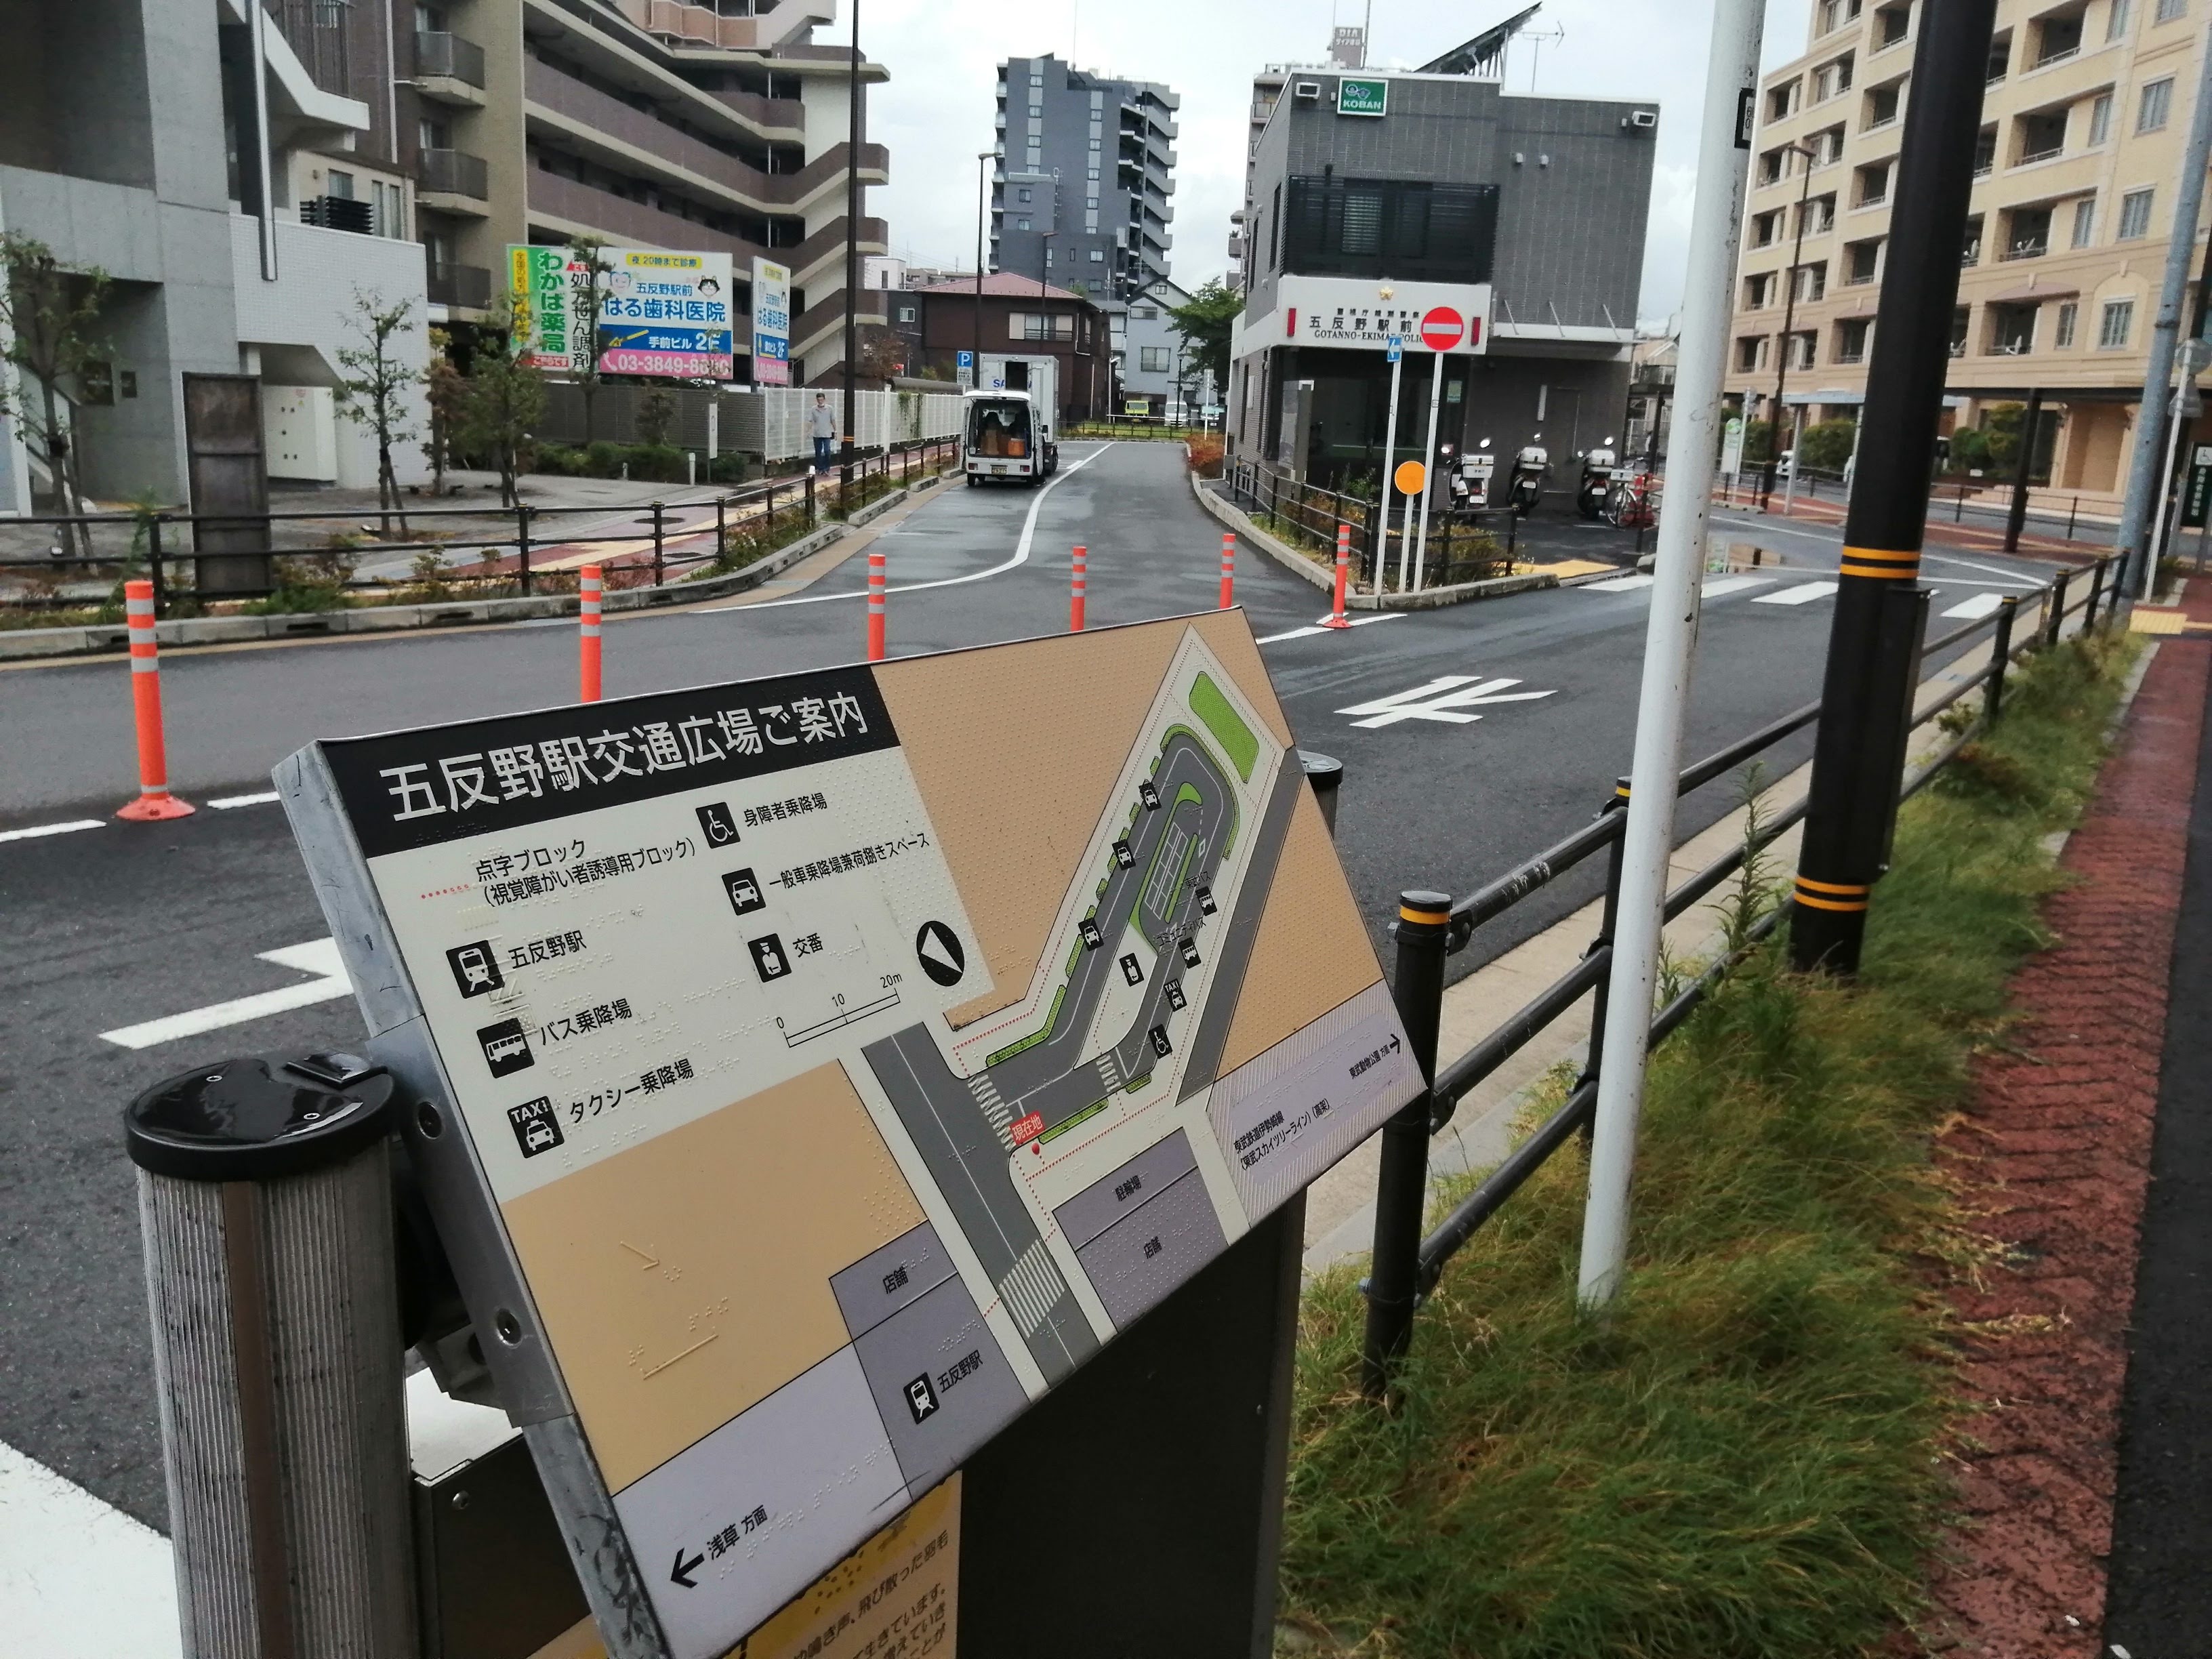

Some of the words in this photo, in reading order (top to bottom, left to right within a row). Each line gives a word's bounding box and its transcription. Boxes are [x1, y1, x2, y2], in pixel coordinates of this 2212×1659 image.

[1343, 99, 1381, 109] KOBAN
[636, 282, 693, 296] 五反野駅前
[605, 297, 726, 323] はる歯科医院
[1309, 315, 1412, 333] 五反野駅前
[649, 336, 692, 350] 手前ビル
[1315, 329, 1397, 341] GOTANNO-EKIMA
[961, 353, 970, 366] P
[379, 691, 868, 822] 五反野駅交通広場ご案内
[743, 792, 827, 827] 身障者乗降場
[476, 839, 586, 882] 点字ブロック
[769, 832, 930, 889] 一般車乗降場兼荷捌きスペース
[792, 933, 824, 958] 交番
[1156, 916, 1206, 947] コミュニティバス
[508, 930, 588, 970] 五反野駅
[879, 972, 903, 990] 20m
[1164, 979, 1181, 993] TAXI
[831, 992, 846, 1008] 10
[540, 998, 633, 1045] バス乗降場
[776, 1016, 785, 1030] 0
[1349, 1050, 1381, 1080] 東武動物公園
[569, 1058, 695, 1124] タクシー乗降場
[511, 1100, 550, 1122] TAXI
[1012, 1114, 1043, 1142] 現在地
[1233, 1110, 1285, 1153] 東武鉄道伊勢崎線
[1115, 1174, 1142, 1202] 駐輪場
[1143, 1235, 1162, 1259] 店舗
[883, 1265, 909, 1294] 店舗
[938, 1350, 983, 1394] 五反野駅
[706, 1523, 741, 1561] 浅草
[741, 1504, 769, 1534] 方面
